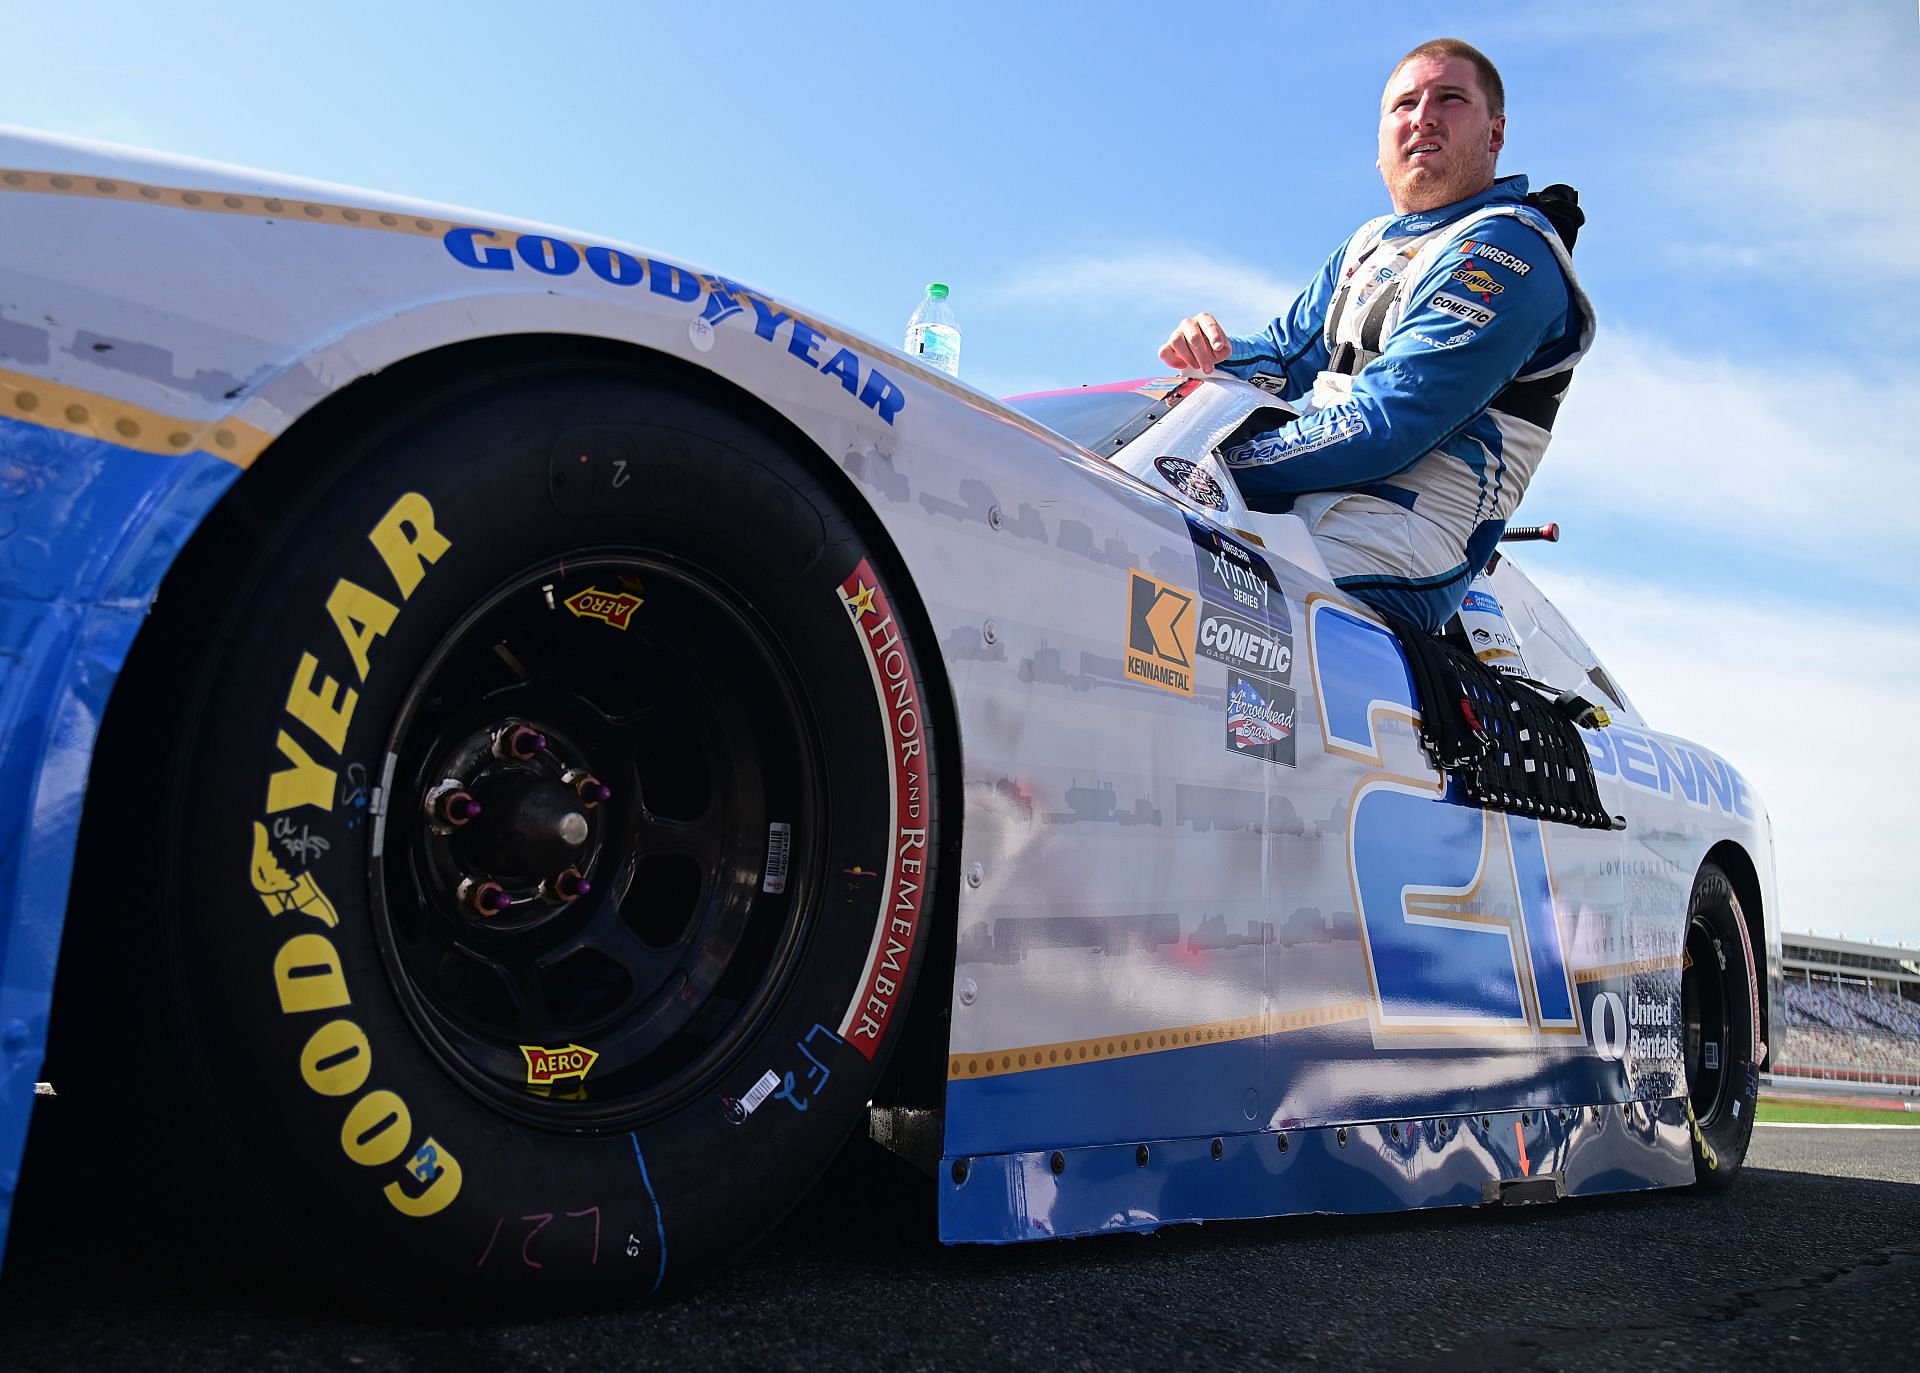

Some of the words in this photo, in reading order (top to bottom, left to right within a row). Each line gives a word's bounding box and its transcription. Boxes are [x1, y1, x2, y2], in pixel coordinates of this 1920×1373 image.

[1475, 244, 1531, 277] NASCAR
[1453, 271, 1504, 294] SUNOCO
[1432, 296, 1490, 323] COMETIC
[1323, 426, 1361, 444] LOGISTICS
[1209, 551, 1268, 606] xfinity
[579, 594, 629, 617] AERO
[1233, 588, 1259, 609] SERIES
[1200, 617, 1291, 673] COMETIC
[1206, 648, 1242, 666] GASKET
[1128, 656, 1190, 691] KENNAMETAL
[868, 614, 921, 767] HONOR
[1228, 689, 1294, 728] Arrowhead
[907, 771, 920, 819] AND
[1600, 861, 1627, 876] LOVE
[854, 826, 926, 1040] REMEMBER
[1628, 995, 1671, 1025] United
[1630, 1029, 1680, 1060] Rentals
[534, 1052, 585, 1074] AERO
